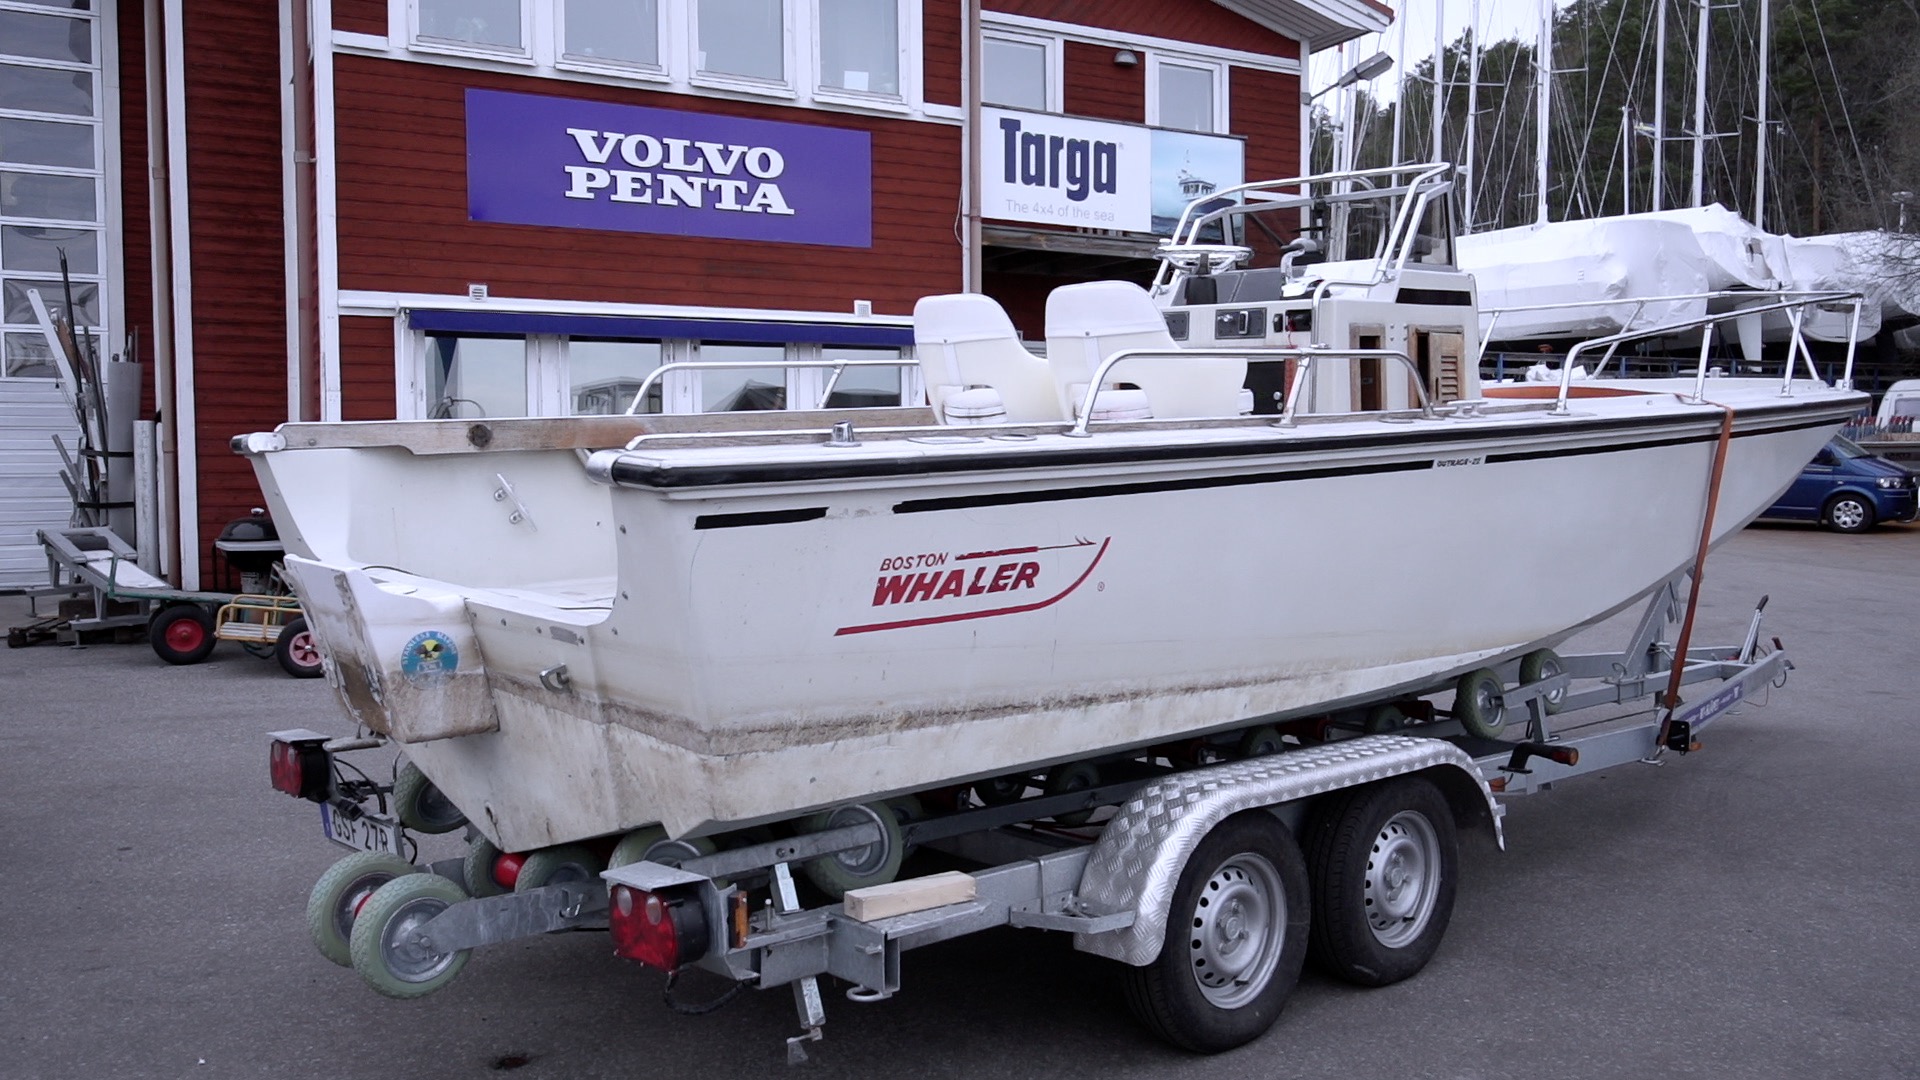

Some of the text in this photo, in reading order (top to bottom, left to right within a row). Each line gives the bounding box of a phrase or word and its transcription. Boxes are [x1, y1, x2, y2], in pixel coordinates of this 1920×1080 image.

[566, 128, 785, 179] VOLVO
[1000, 117, 1117, 202] Targa
[564, 165, 796, 215] PENTA
[1006, 199, 1115, 222] The 4x4 of the sea
[871, 561, 1040, 607] WHALER
[879, 552, 949, 572] BOSTON
